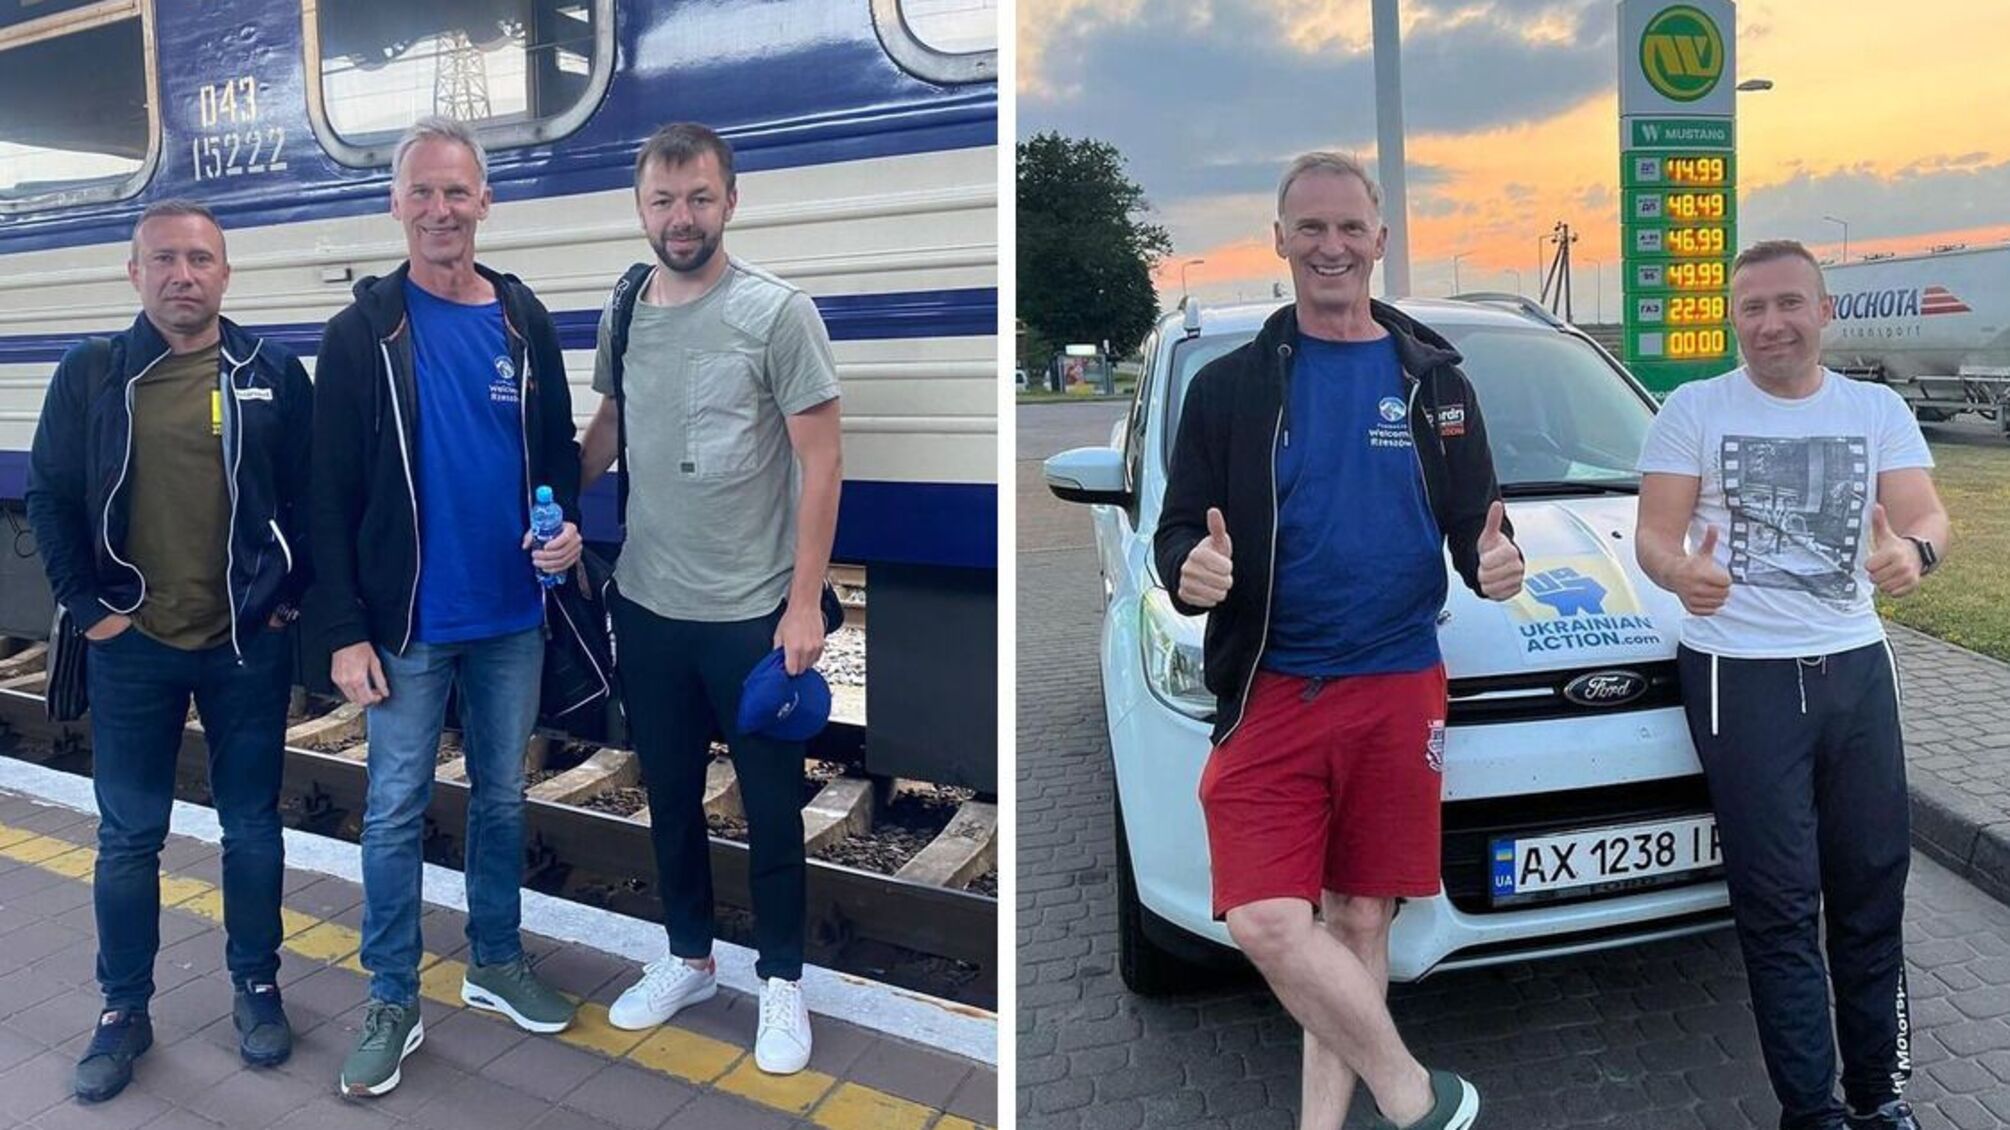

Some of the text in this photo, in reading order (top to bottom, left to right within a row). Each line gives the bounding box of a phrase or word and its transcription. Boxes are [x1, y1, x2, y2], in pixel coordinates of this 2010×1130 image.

[200, 76, 257, 127] 043
[1665, 128, 1726, 140] MUSTANG
[193, 127, 288, 181] 15222
[1668, 194, 1724, 217] 48.49
[1669, 228, 1724, 252] 46.99
[1669, 262, 1724, 286] 49.99
[1669, 296, 1725, 321] 22.98
[1842, 325, 1921, 338] transport
[1519, 615, 1654, 638] UKRAINIAN
[1527, 631, 1660, 653] ACTION.com
[1585, 676, 1633, 700] Ford
[1519, 842, 1578, 886] AX
[1590, 831, 1676, 876] 1238
[1495, 874, 1513, 887] UA
